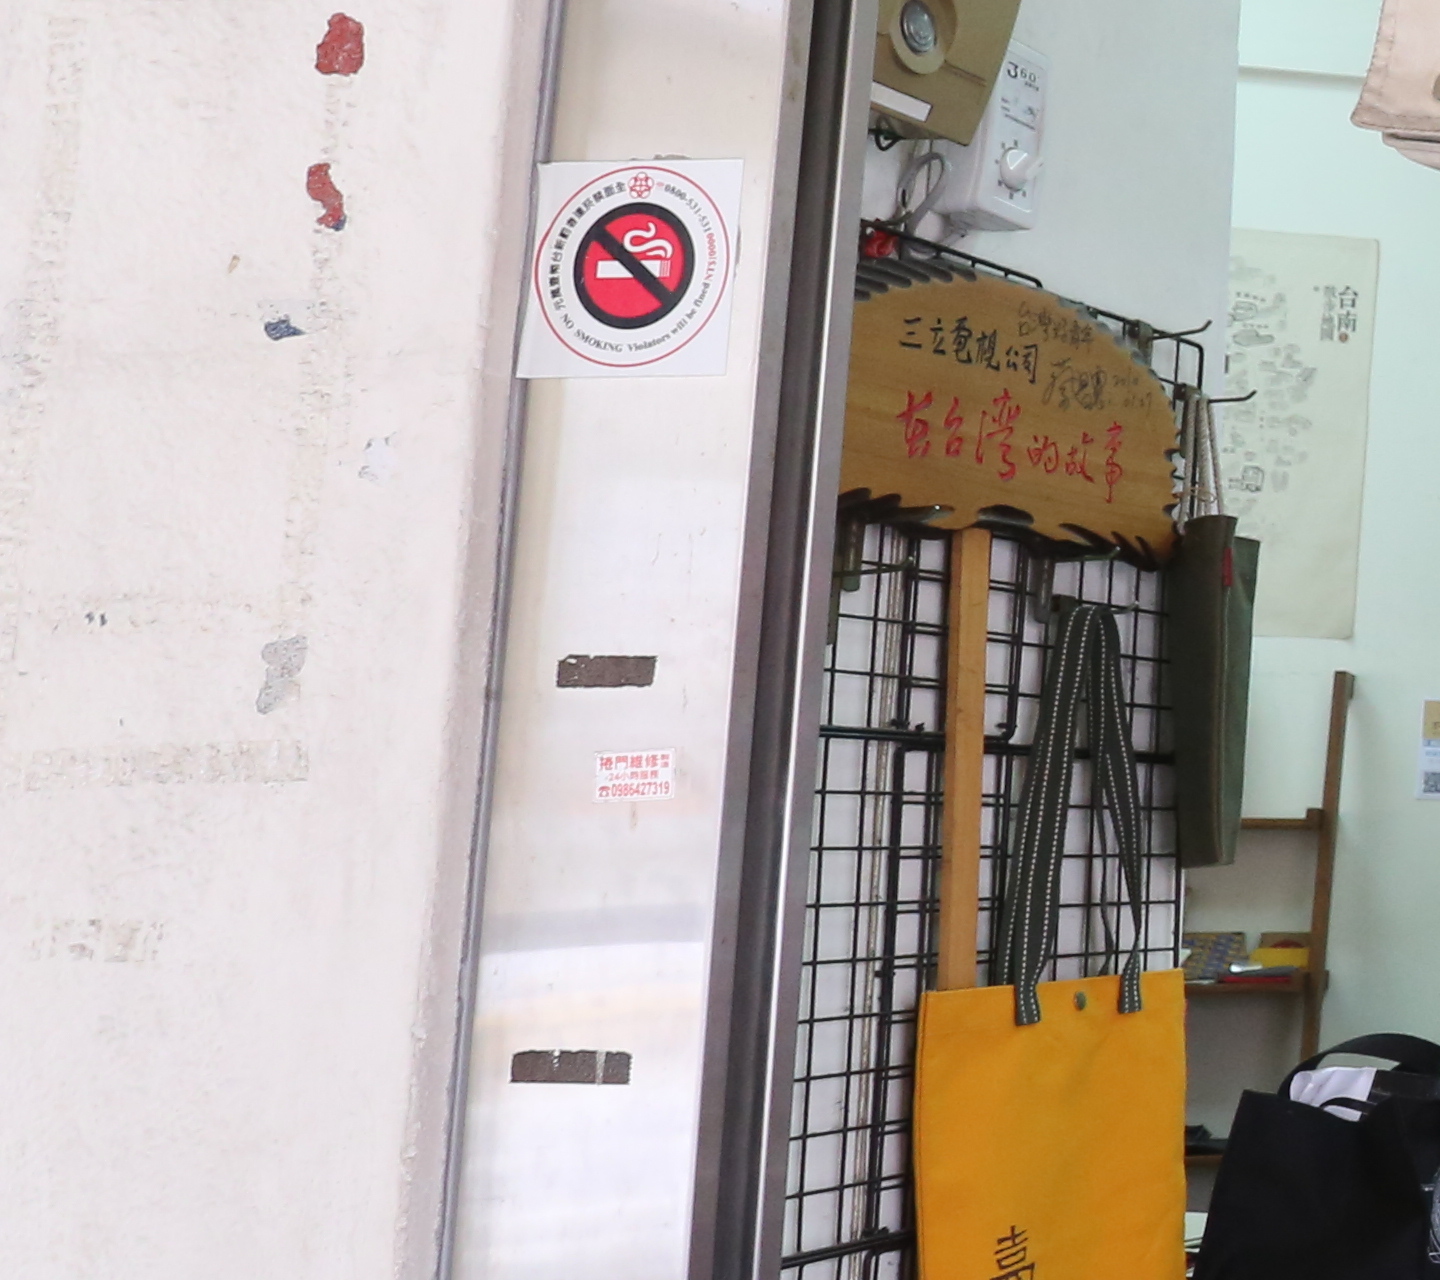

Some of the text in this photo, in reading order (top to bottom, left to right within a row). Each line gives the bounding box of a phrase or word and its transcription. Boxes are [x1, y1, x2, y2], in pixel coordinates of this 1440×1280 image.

[561, 313, 575, 331] NO
[573, 328, 624, 353] SMOKING
[899, 316, 1039, 385] 三立電視公司
